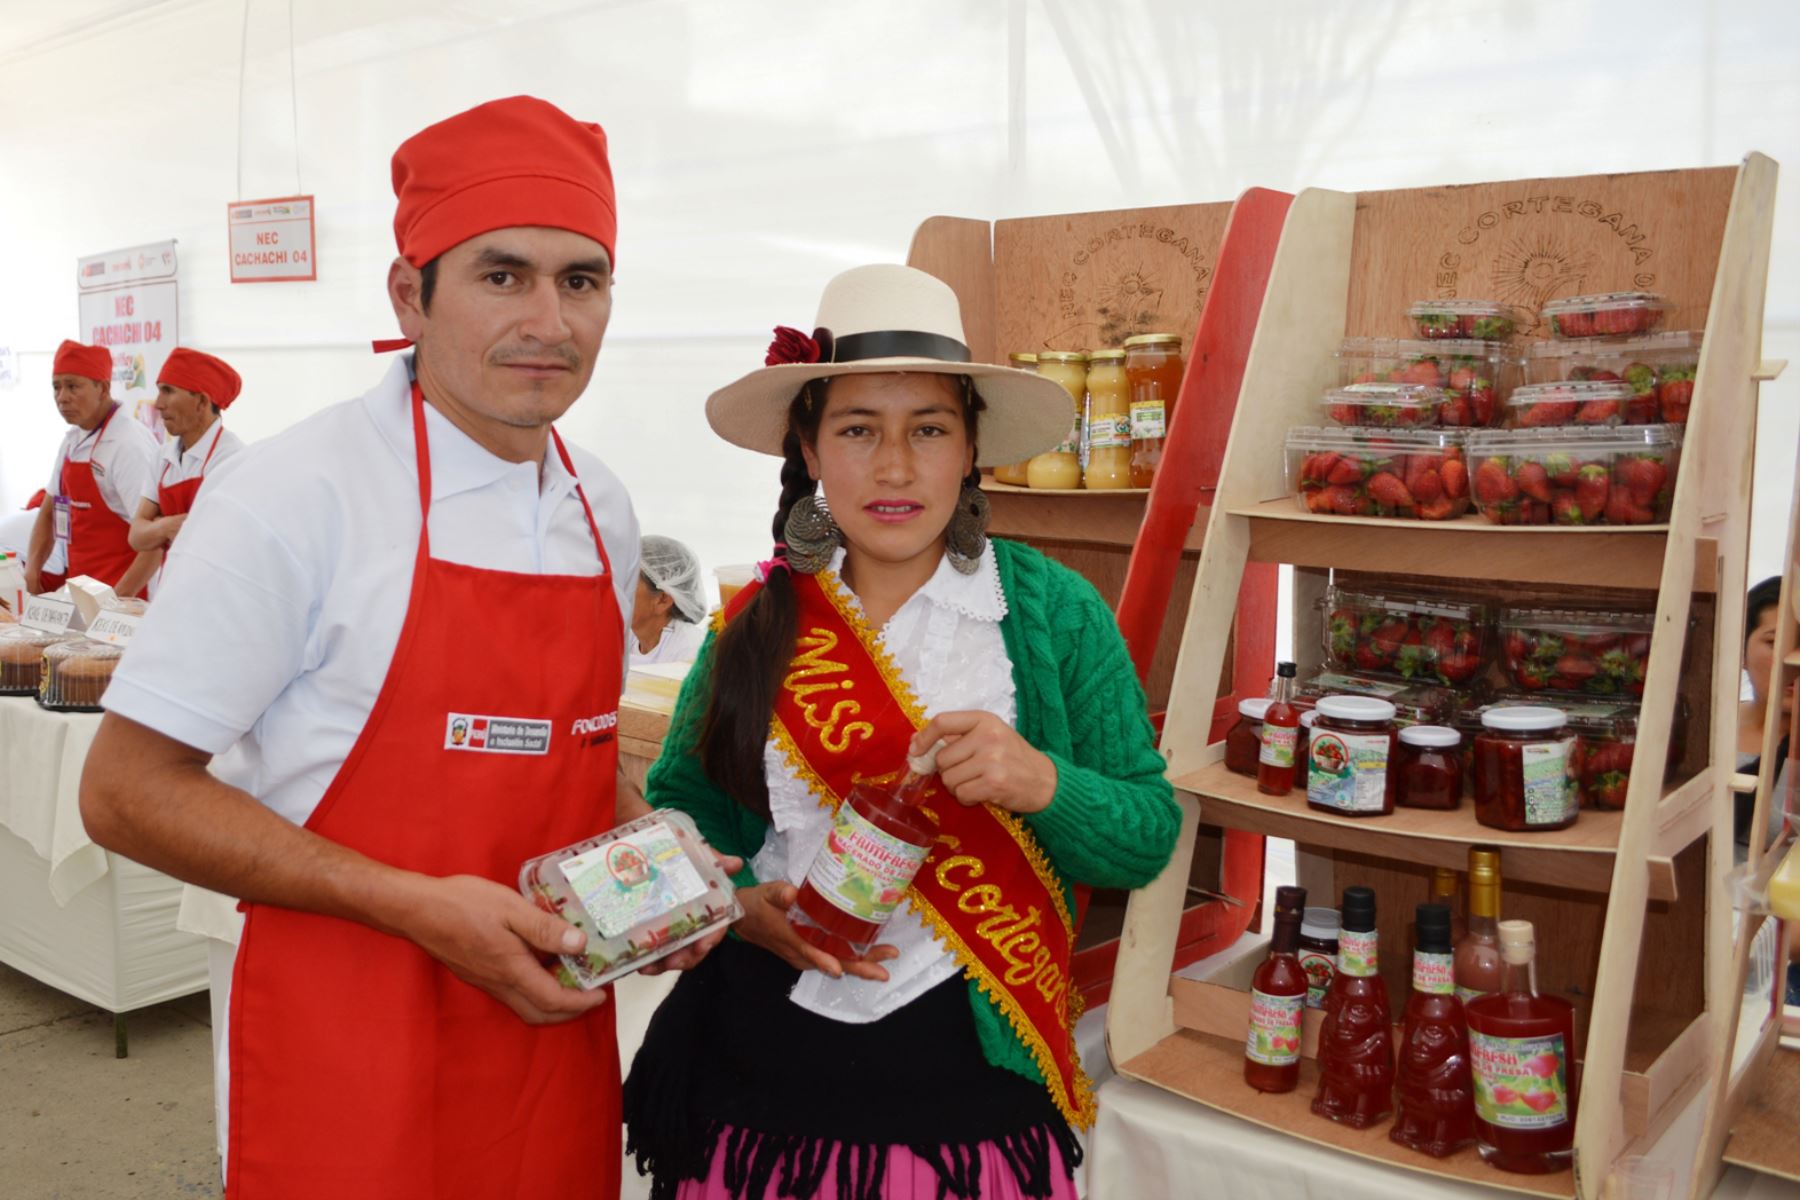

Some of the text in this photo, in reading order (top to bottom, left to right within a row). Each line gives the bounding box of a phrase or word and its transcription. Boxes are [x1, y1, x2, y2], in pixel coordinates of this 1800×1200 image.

[256, 231, 279, 245] NEC
[1458, 196, 1653, 266] CORTEGANA
[235, 249, 308, 266] CACHACHI 04
[1073, 224, 1210, 282] CORTEGANA
[115, 294, 135, 317] NEC
[92, 319, 162, 347] CACHACHI 04
